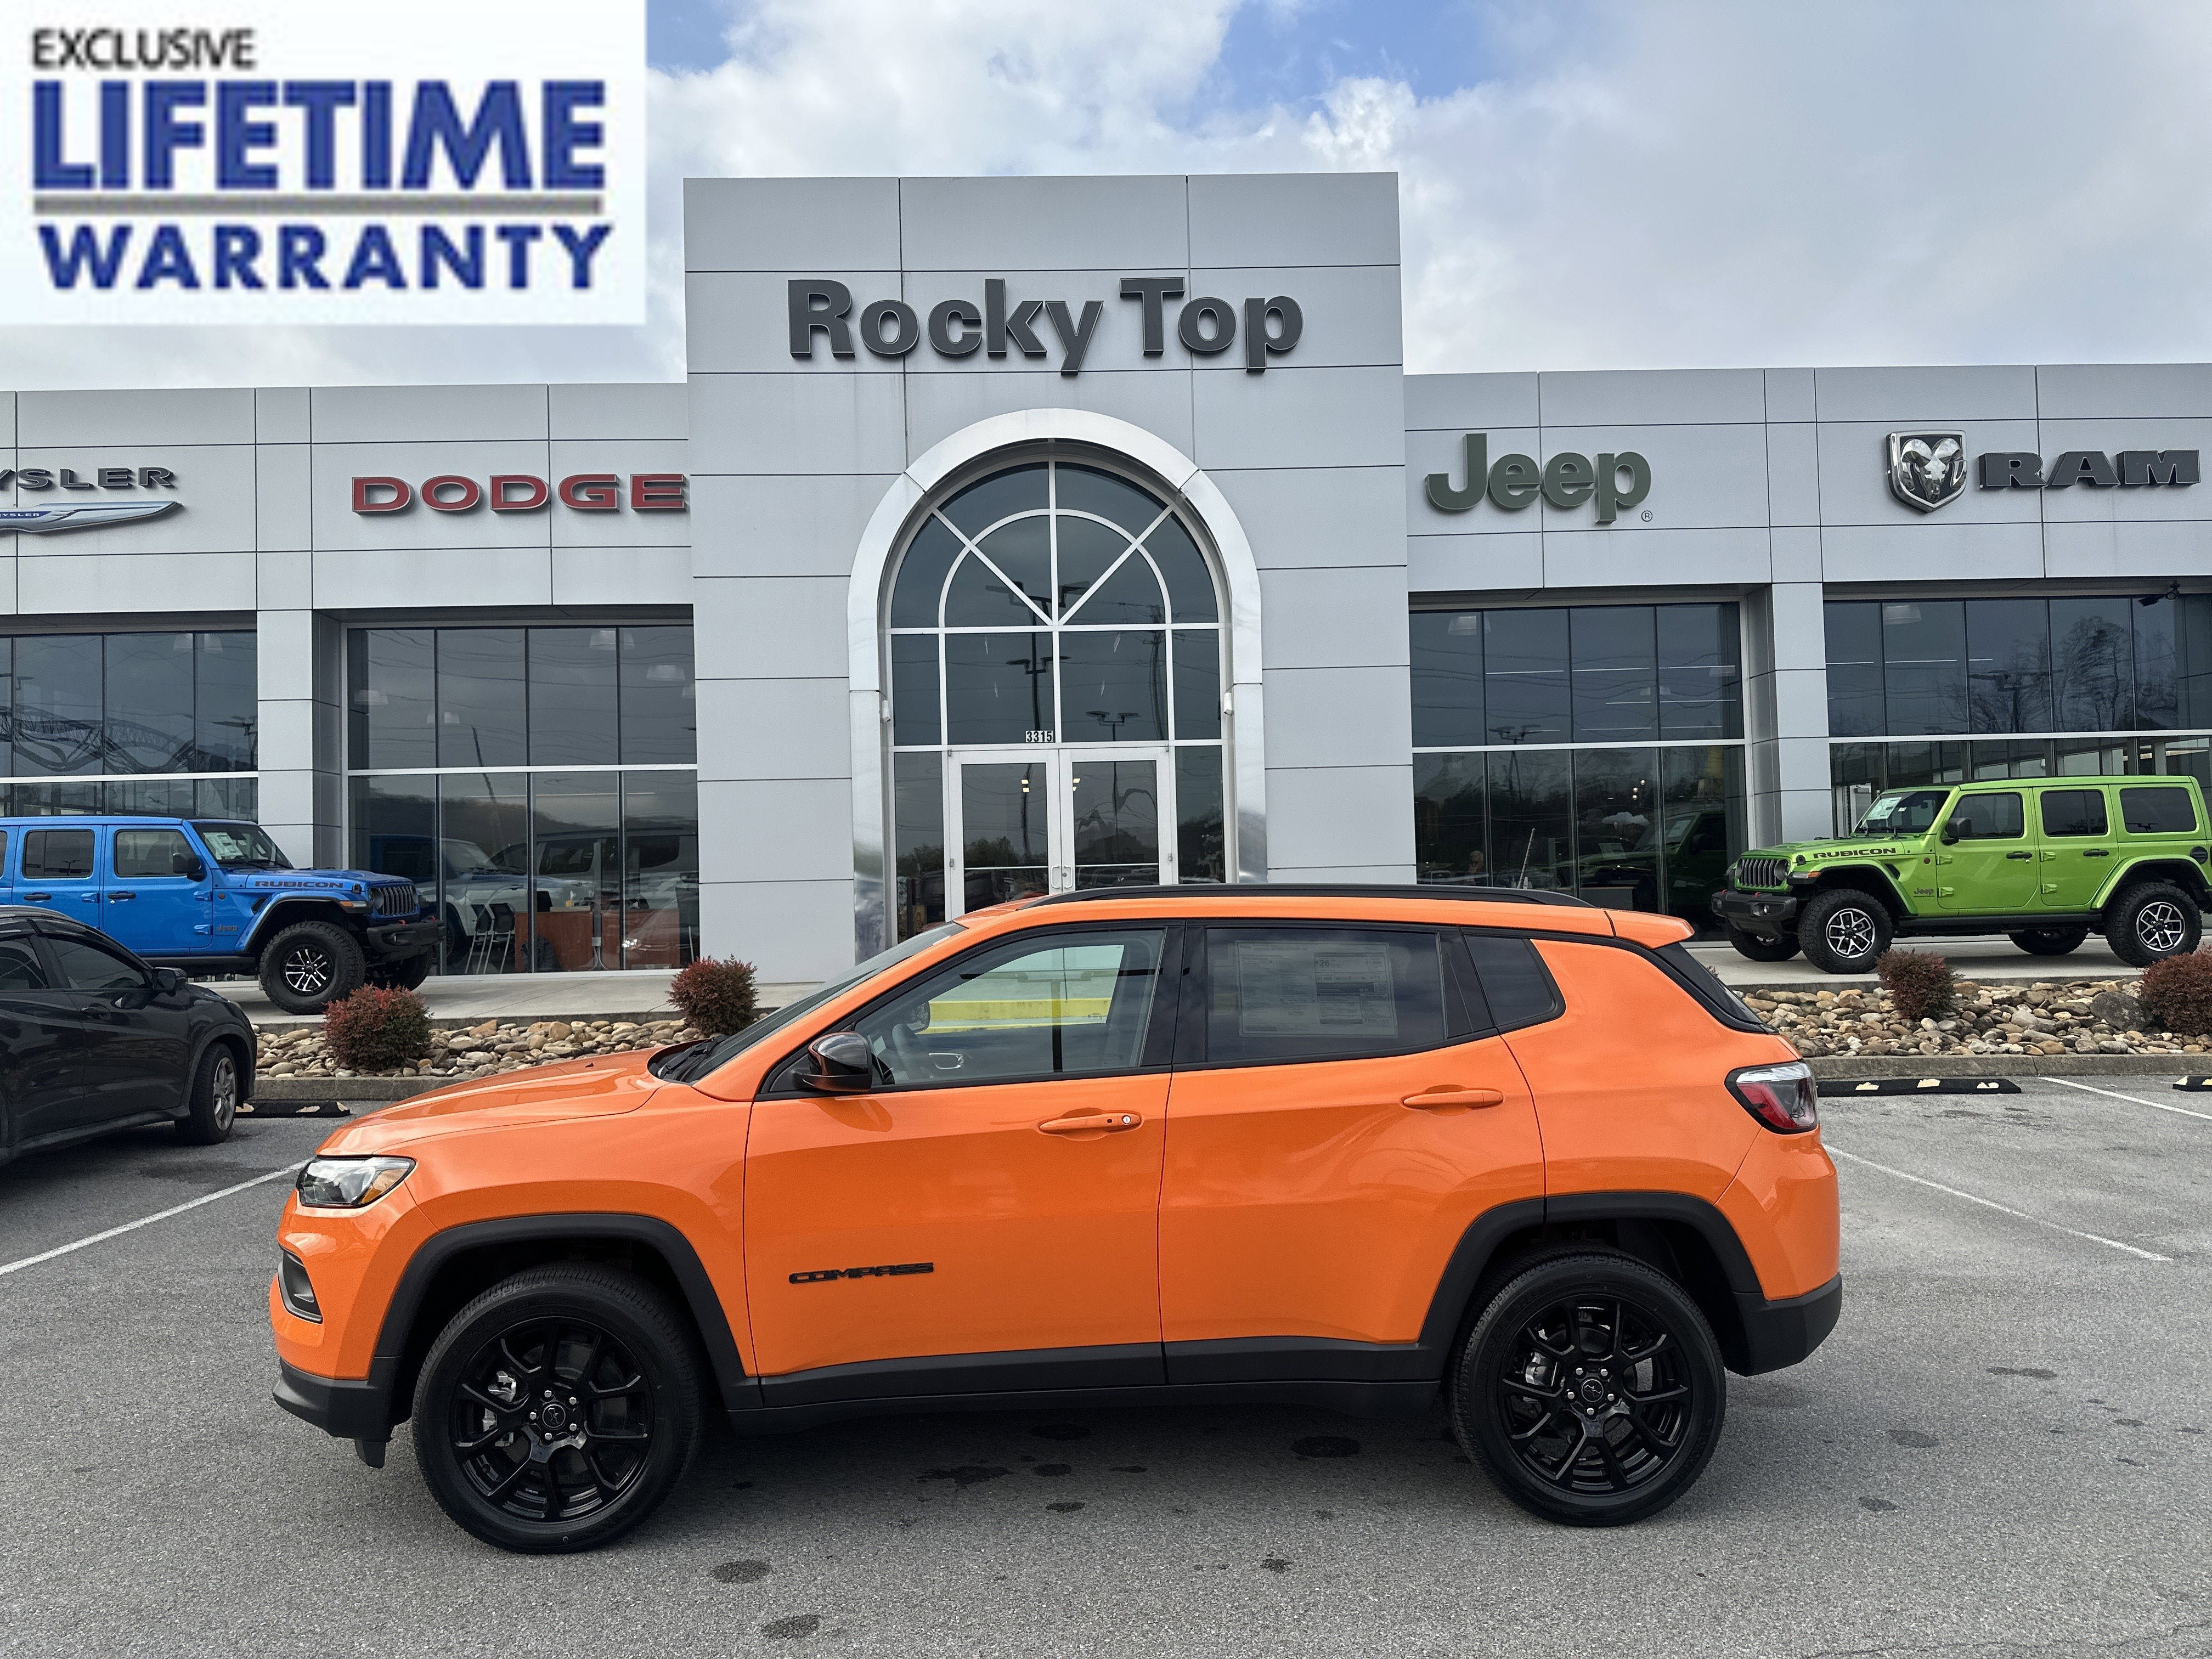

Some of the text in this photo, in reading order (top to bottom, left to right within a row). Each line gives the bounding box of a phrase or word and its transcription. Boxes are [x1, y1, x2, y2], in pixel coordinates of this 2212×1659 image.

[788, 277, 1304, 375] Rocky Top
[1425, 433, 1651, 523] Jeep
[1978, 450, 2200, 489] RAM
[352, 474, 686, 514] DODGE
[1026, 731, 1052, 742] 3315
[1813, 848, 1897, 859] RUBICON
[216, 924, 238, 932] Jeep
[789, 1262, 934, 1284] COMPASS
